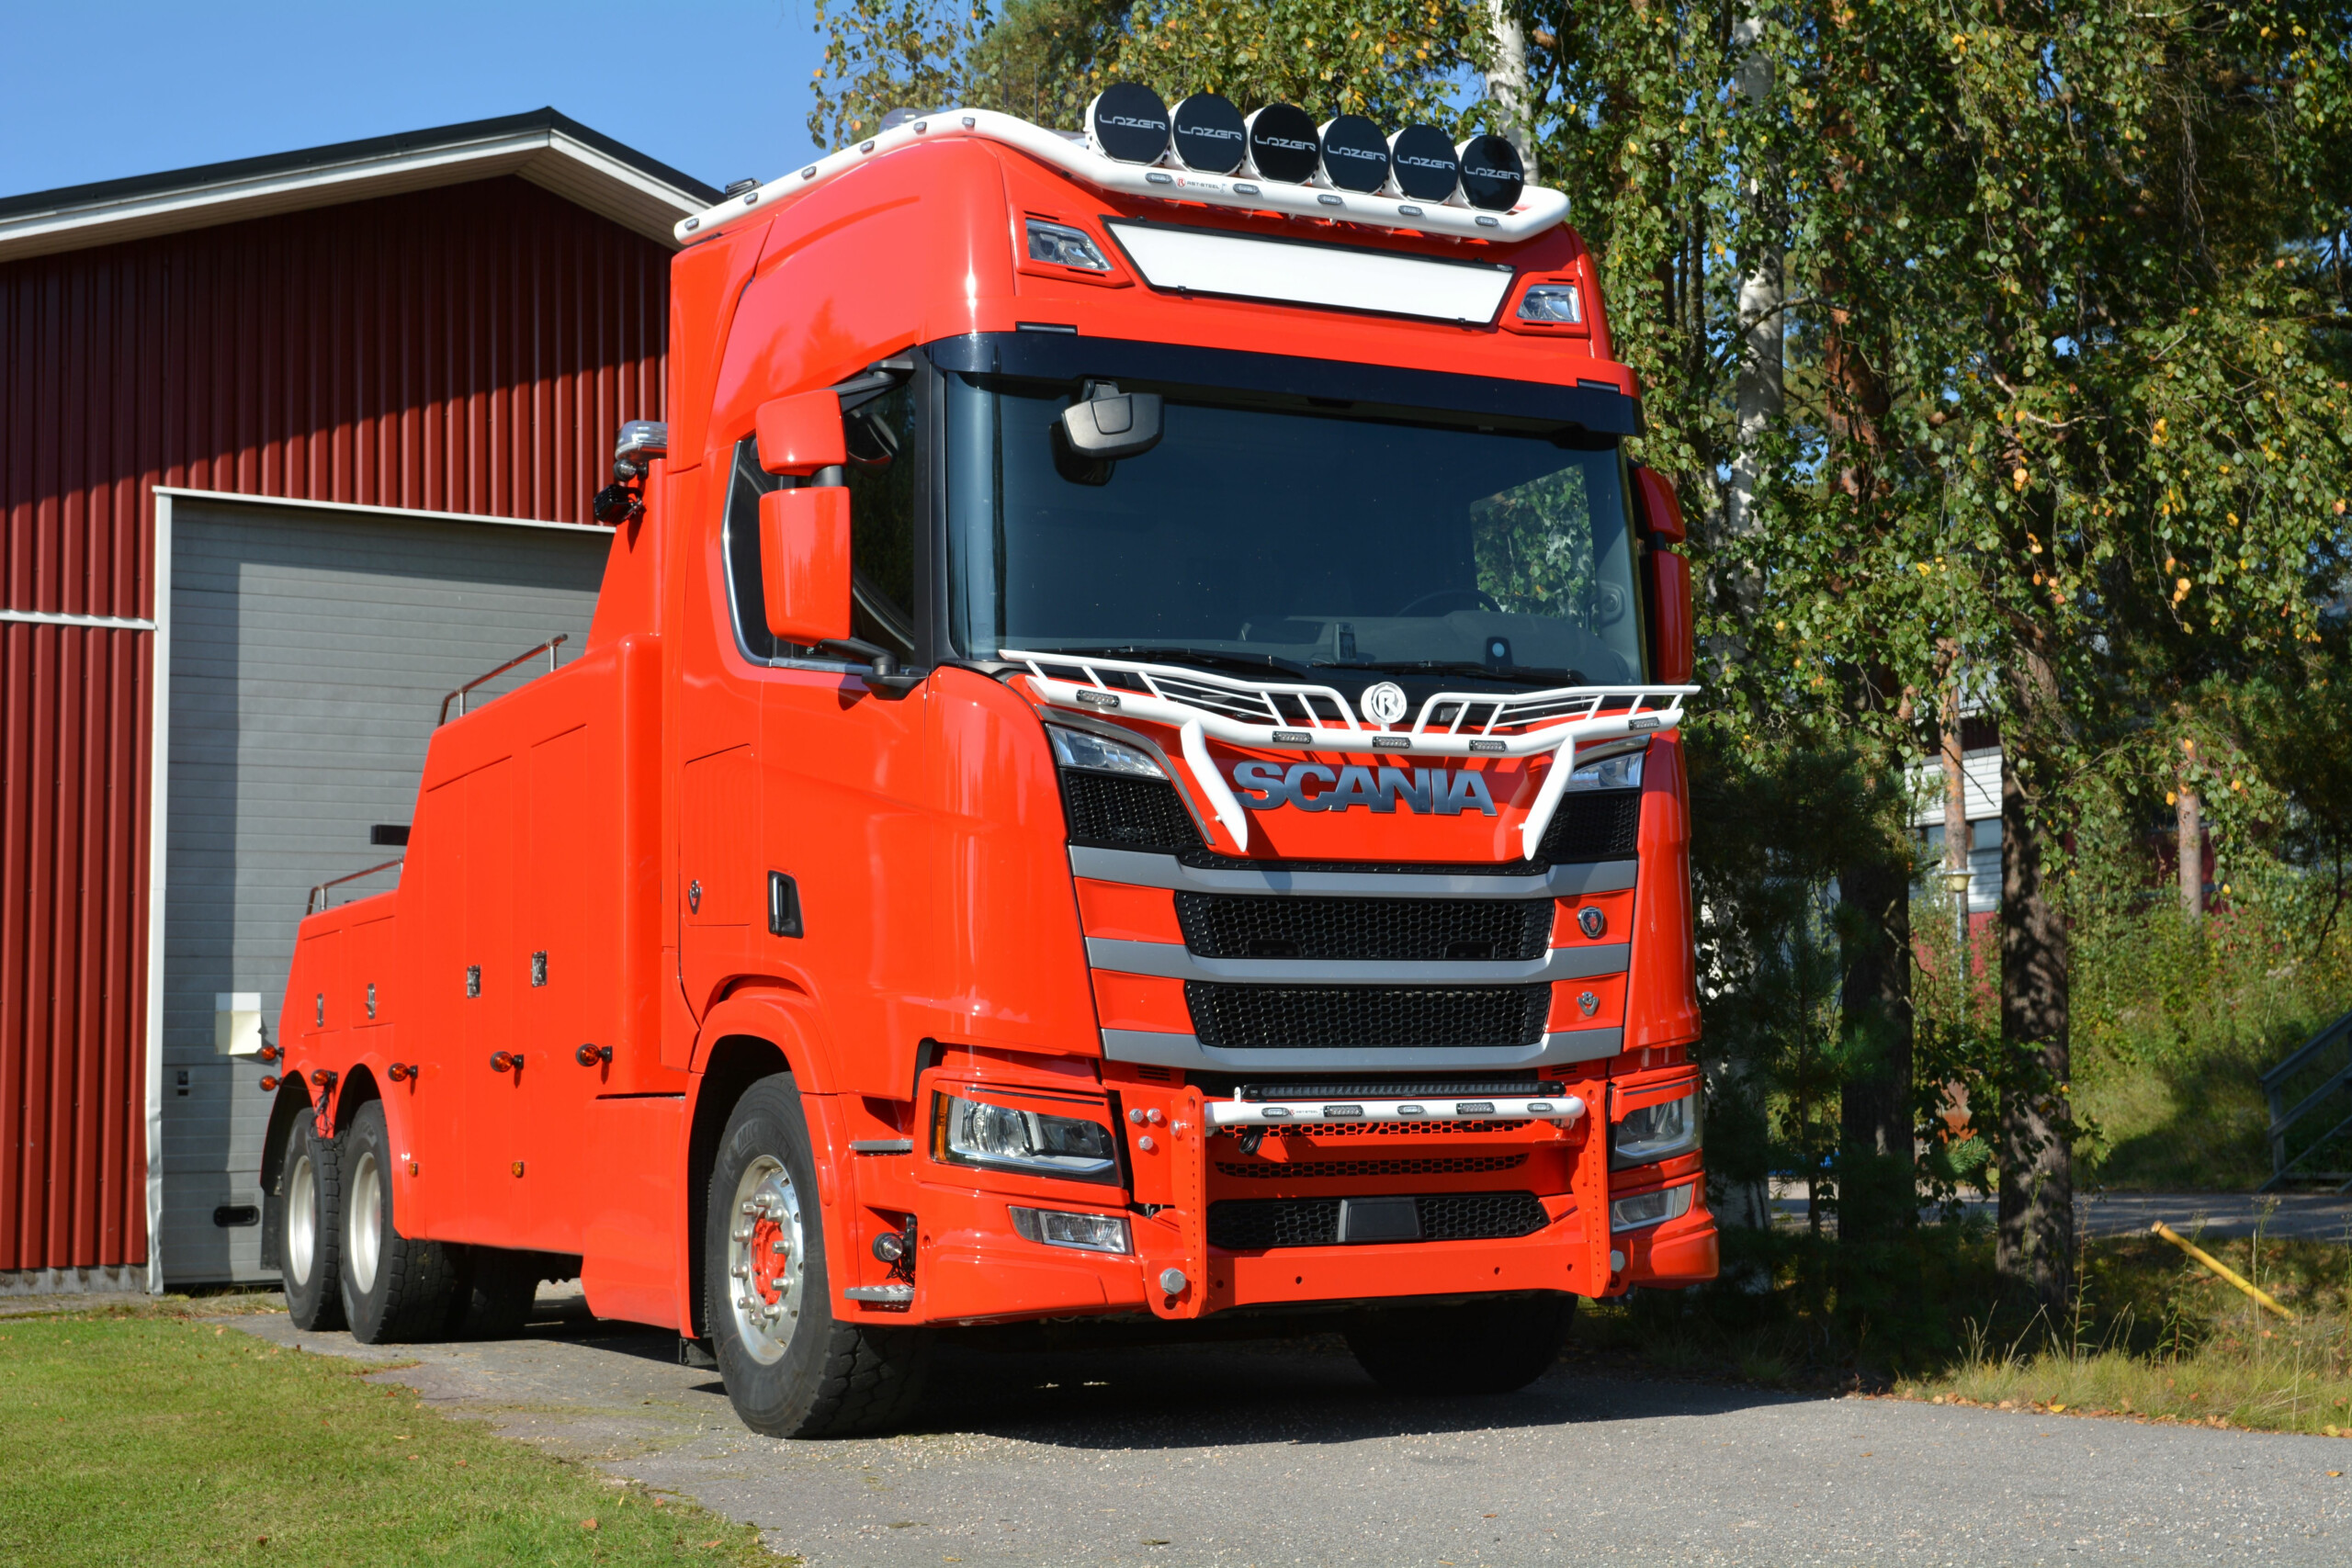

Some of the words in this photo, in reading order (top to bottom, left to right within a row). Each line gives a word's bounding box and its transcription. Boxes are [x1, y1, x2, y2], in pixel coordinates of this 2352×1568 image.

[1099, 114, 1166, 130] LAZER
[1178, 124, 1242, 141] LAZER
[1254, 134, 1317, 152] LAZER
[1327, 144, 1386, 162] LAZER
[1396, 154, 1455, 171] LAZER
[1464, 165, 1521, 181] LAZER
[1233, 760, 1498, 816] SCANIA
